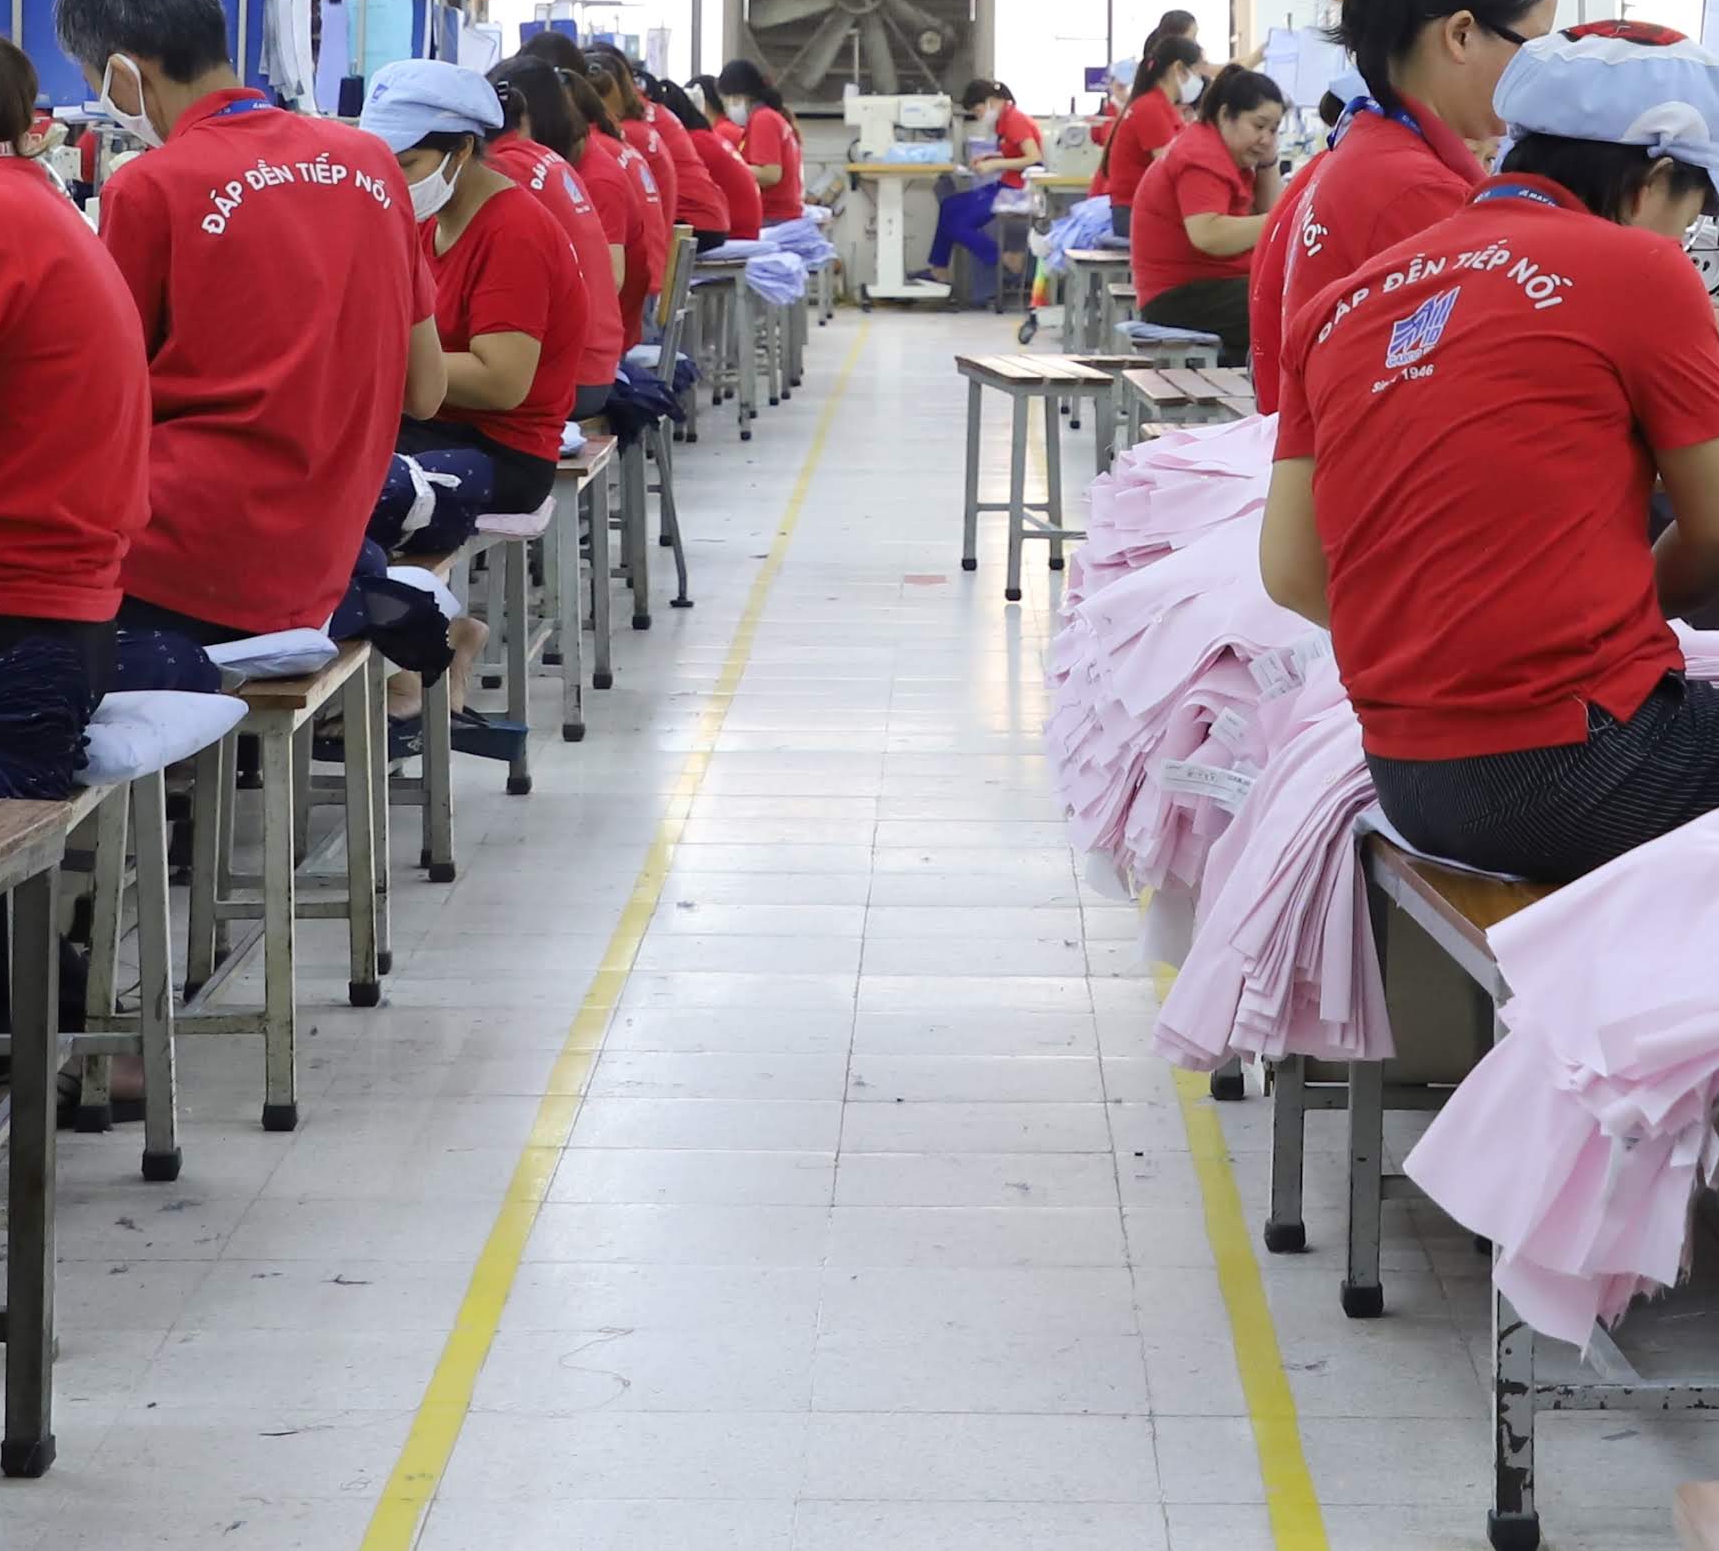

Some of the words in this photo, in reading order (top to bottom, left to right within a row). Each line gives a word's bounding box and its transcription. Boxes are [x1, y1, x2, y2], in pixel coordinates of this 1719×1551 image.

[201, 181, 243, 235] ĐÁP
[244, 158, 295, 192] ĐỀN
[295, 152, 348, 185] TIẾP
[354, 169, 392, 210] NỐI
[1383, 252, 1447, 294] ĐỀN
[1451, 238, 1512, 271] TIẾP
[1506, 256, 1574, 310] NỐI
[1402, 364, 1435, 380] 1946
